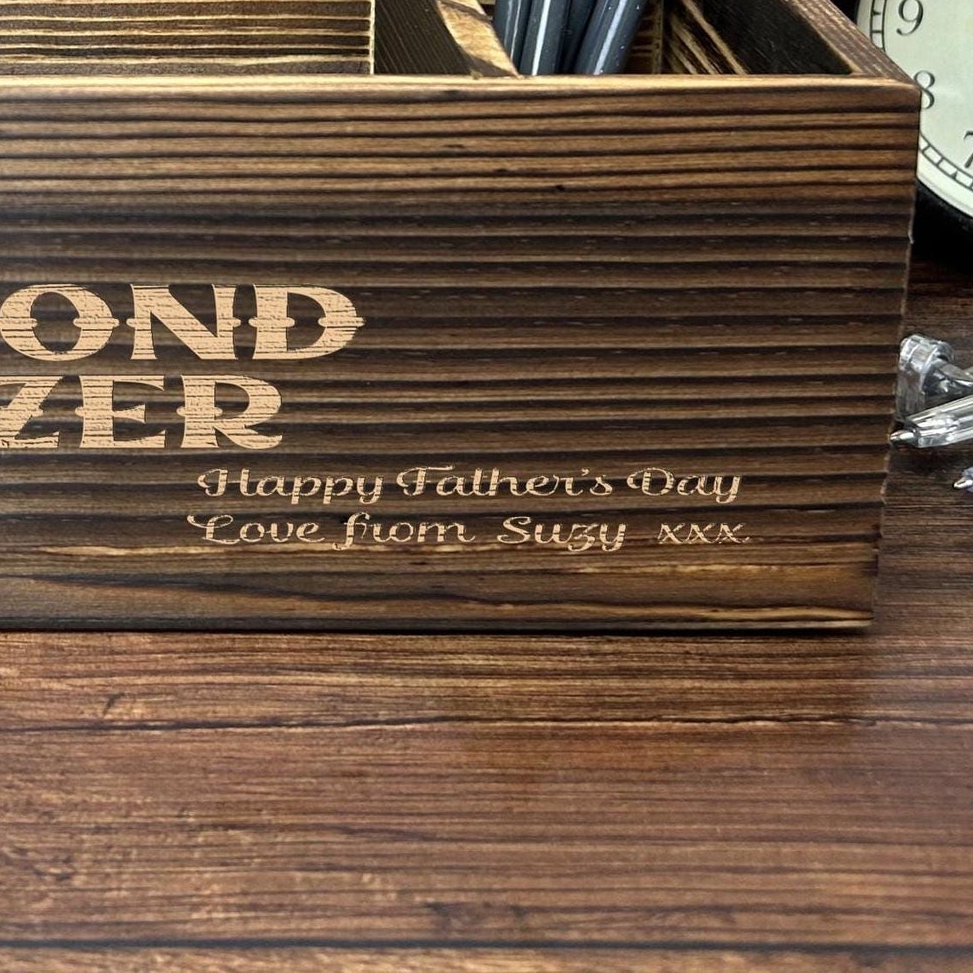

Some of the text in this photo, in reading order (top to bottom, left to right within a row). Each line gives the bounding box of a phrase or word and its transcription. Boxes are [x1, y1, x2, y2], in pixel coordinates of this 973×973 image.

[197, 465, 742, 505] Happy Father's Day
[187, 514, 325, 545] Love
[332, 512, 476, 551] from
[496, 515, 627, 552] Suzy
